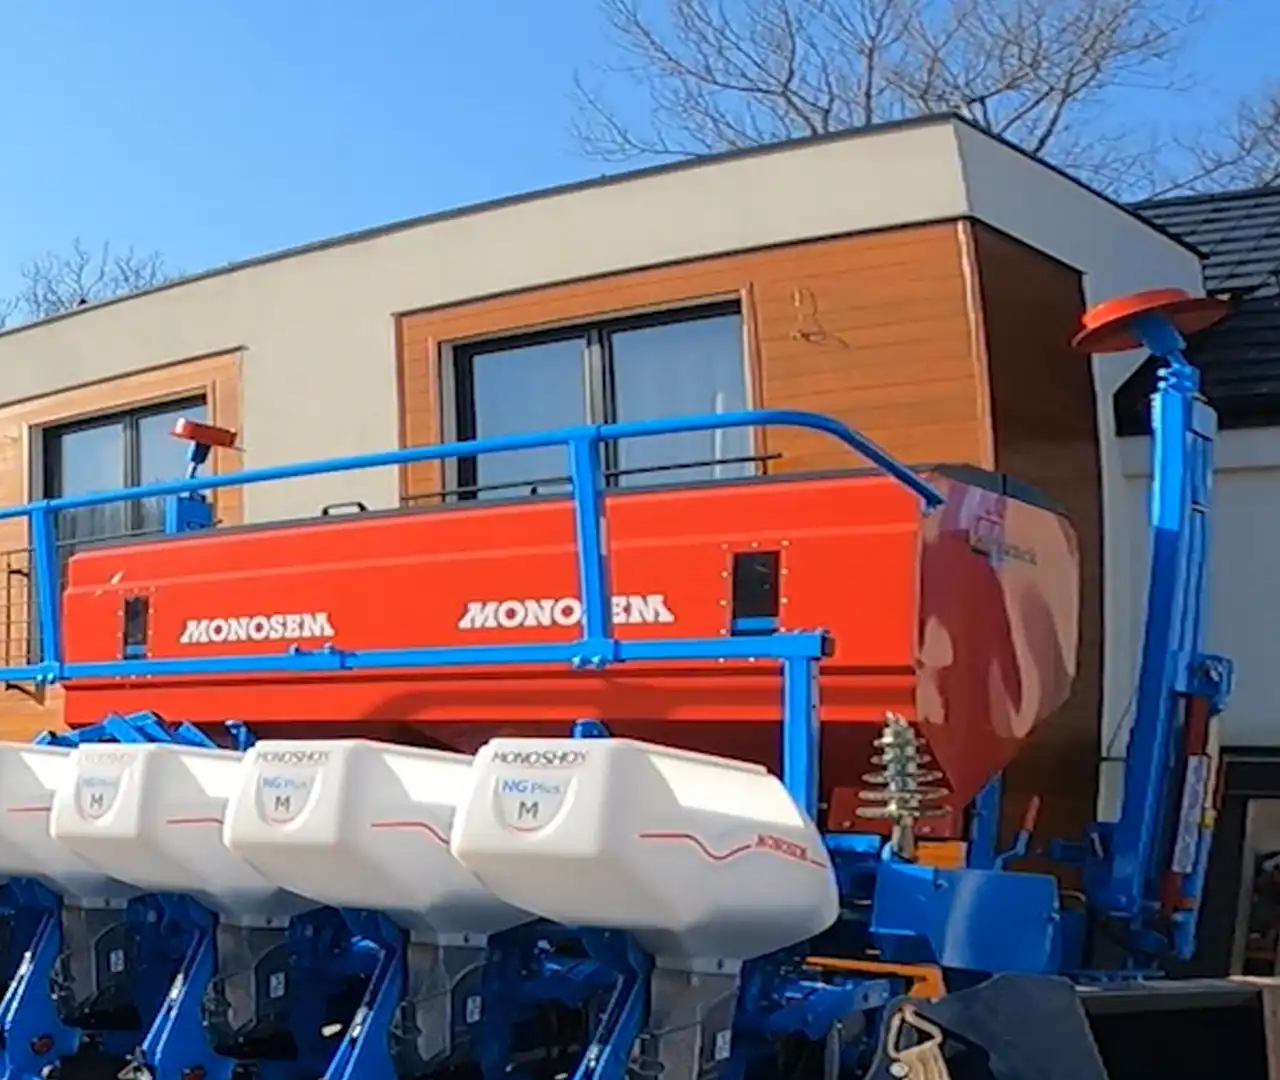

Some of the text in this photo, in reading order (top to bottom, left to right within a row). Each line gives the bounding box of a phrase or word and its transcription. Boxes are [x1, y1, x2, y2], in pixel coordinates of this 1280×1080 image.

[458, 593, 675, 629] MONOEM
[180, 612, 336, 644] MONOSEM
[502, 779, 529, 793] NG
[274, 795, 291, 813] M
[517, 799, 540, 820] M
